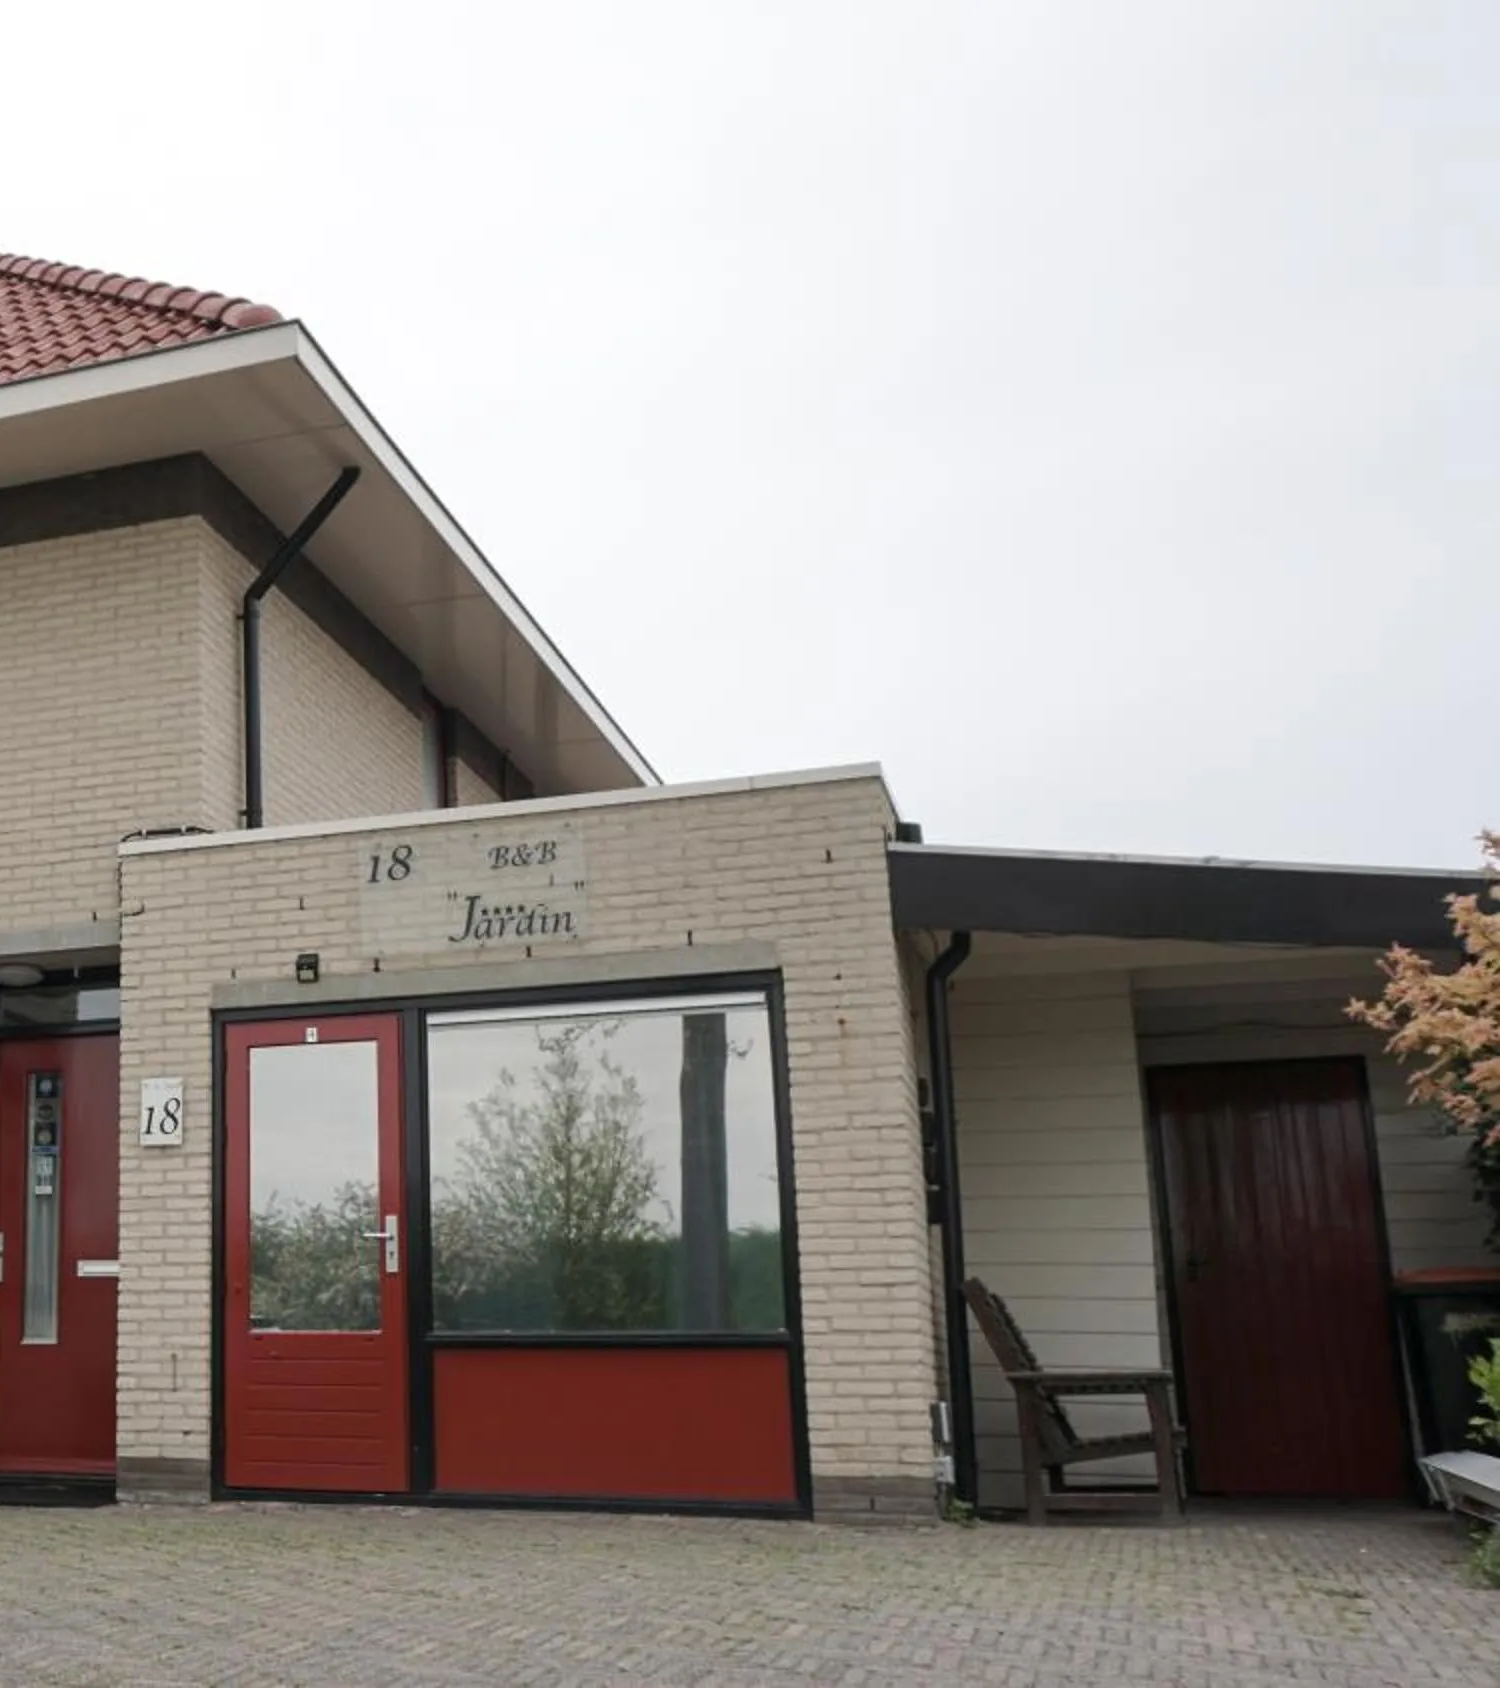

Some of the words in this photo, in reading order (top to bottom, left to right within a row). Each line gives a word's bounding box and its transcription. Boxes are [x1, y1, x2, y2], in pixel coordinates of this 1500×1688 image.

[367, 844, 413, 883] 18
[488, 840, 557, 870] B&B
[143, 1097, 181, 1135] 18
